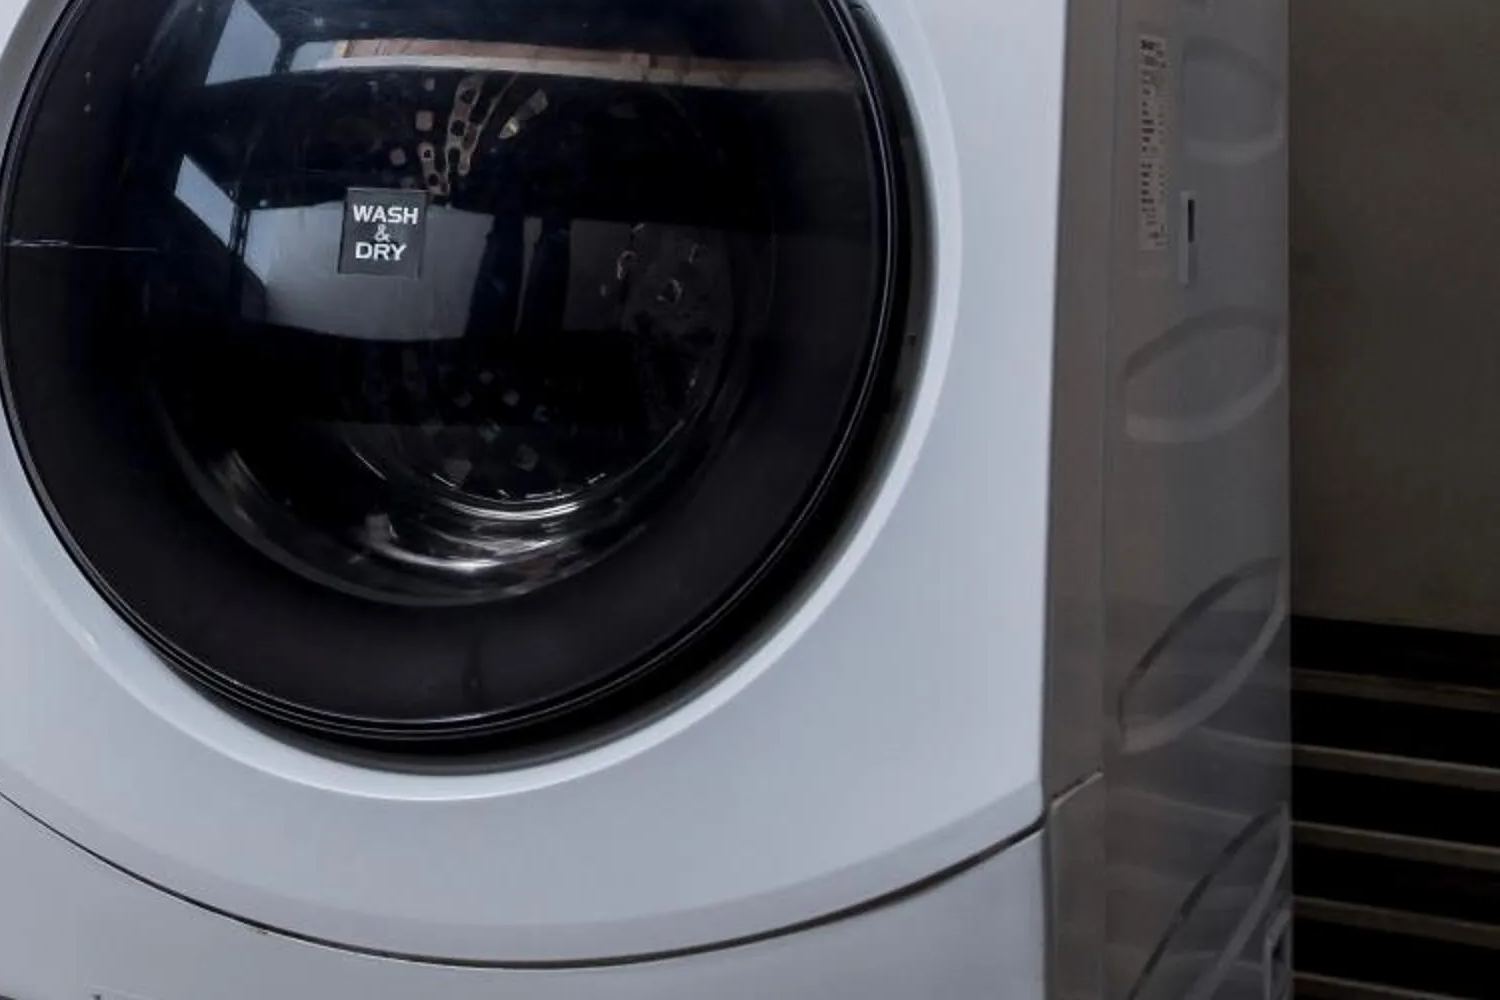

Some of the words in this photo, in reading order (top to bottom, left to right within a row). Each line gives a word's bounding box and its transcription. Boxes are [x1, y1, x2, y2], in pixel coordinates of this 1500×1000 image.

[352, 204, 419, 225] WASH
[374, 223, 391, 242] &
[355, 242, 407, 261] DRY
